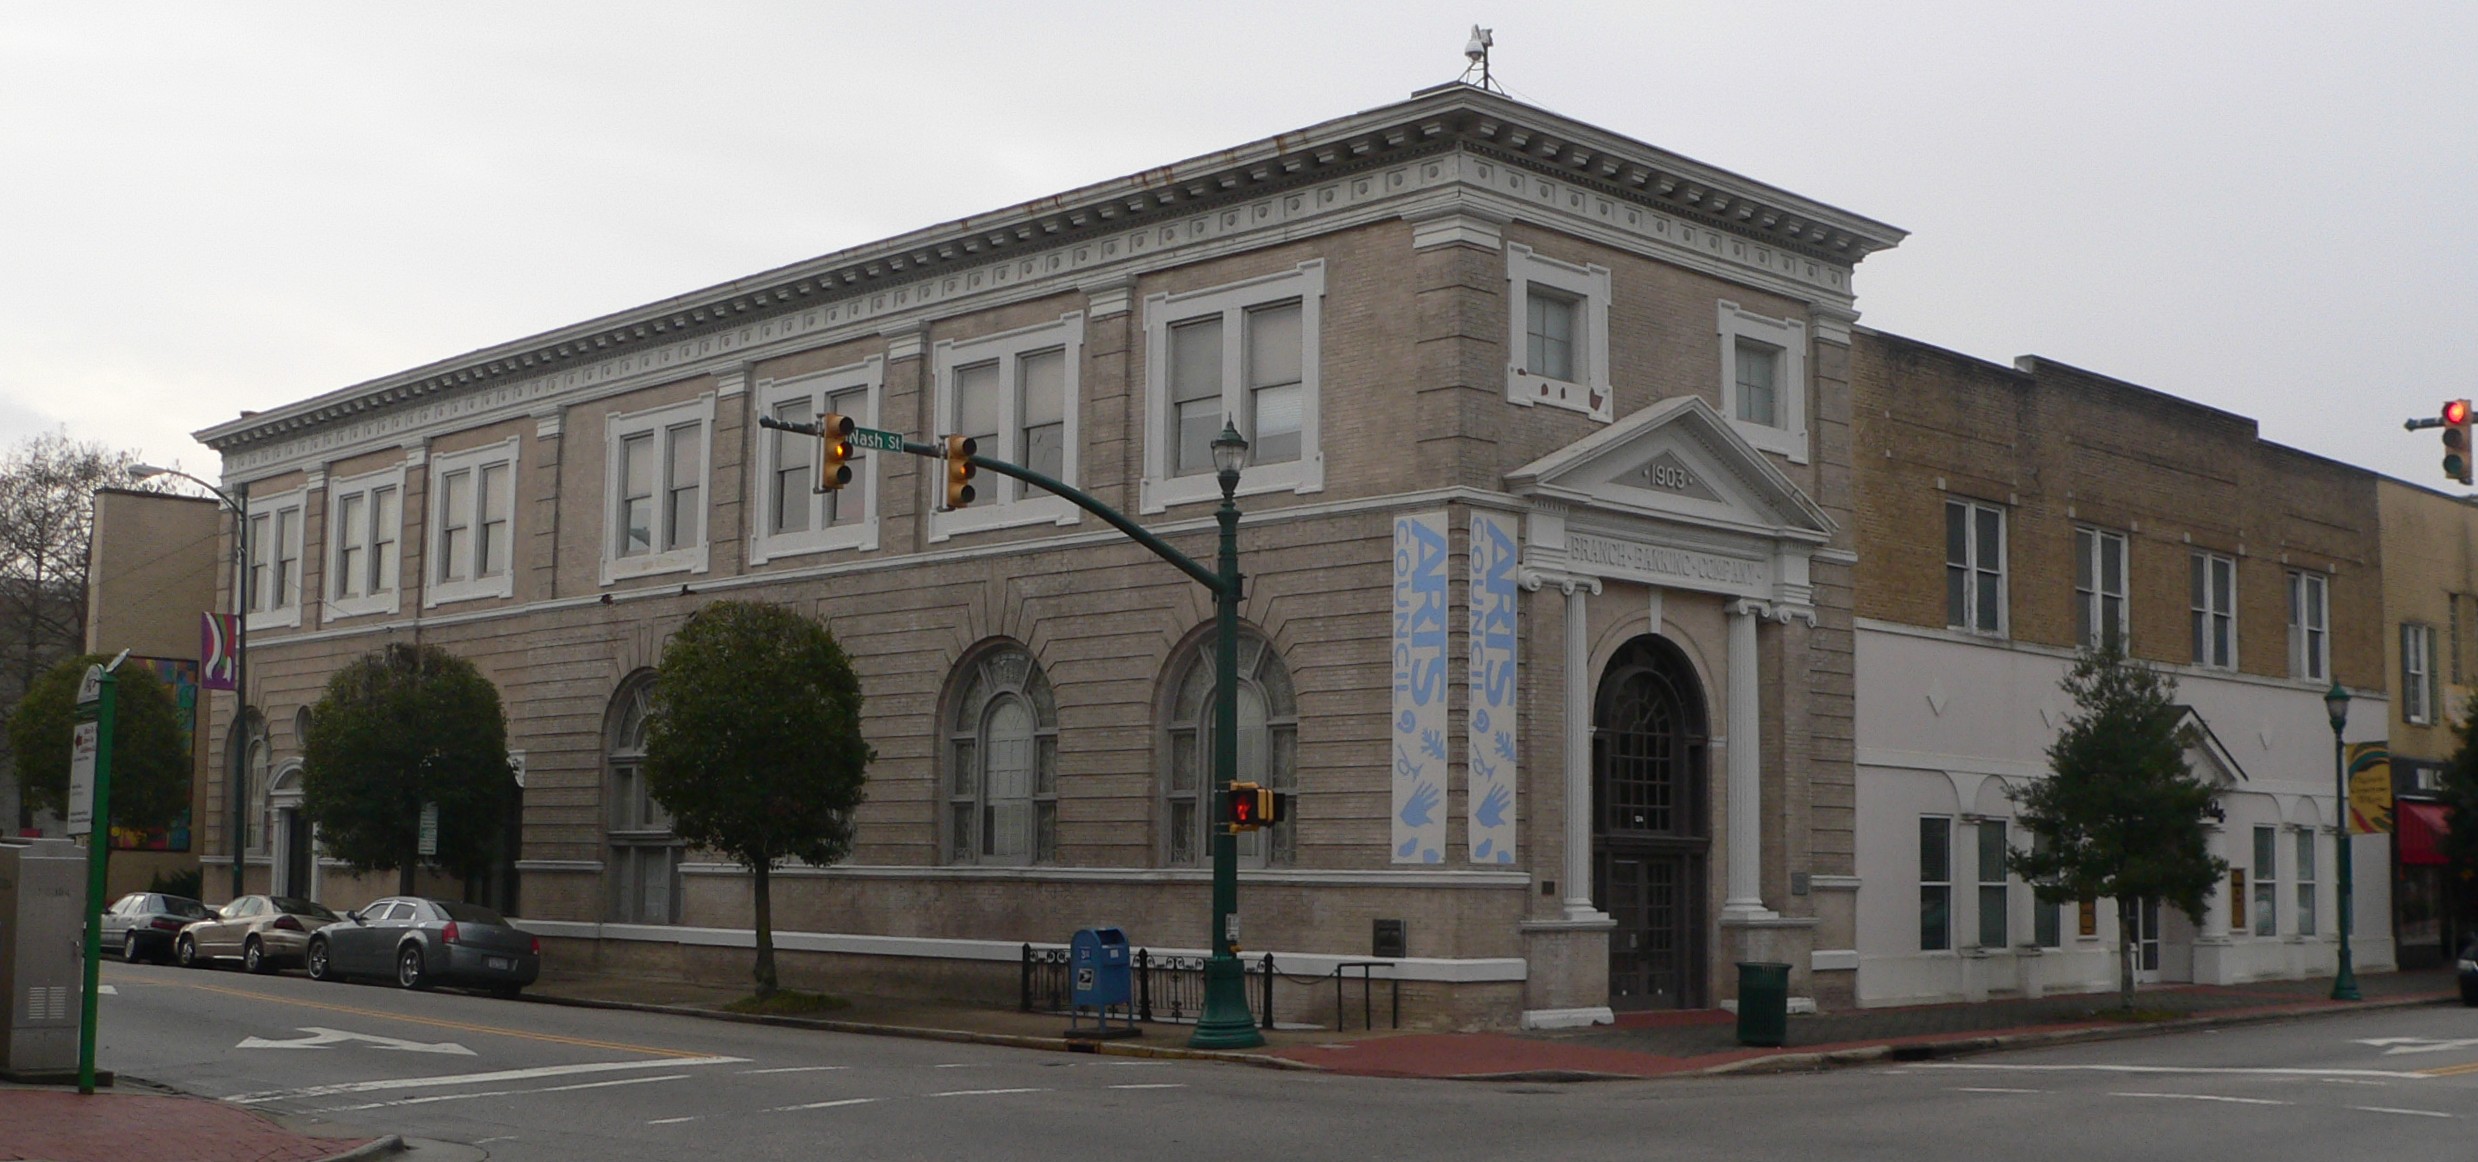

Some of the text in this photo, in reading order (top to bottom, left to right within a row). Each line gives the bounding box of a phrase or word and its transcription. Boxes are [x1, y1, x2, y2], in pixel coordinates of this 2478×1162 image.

[848, 429, 901, 450] Nash St
[1651, 464, 1686, 489] 1903
[1395, 520, 1409, 704] COUNCIL
[1411, 518, 1447, 707] ARTS
[1471, 517, 1484, 703] COUNCIL
[1486, 518, 1516, 708] ARTS
[1570, 536, 1755, 586] BRANCH BANKING COMPANY
